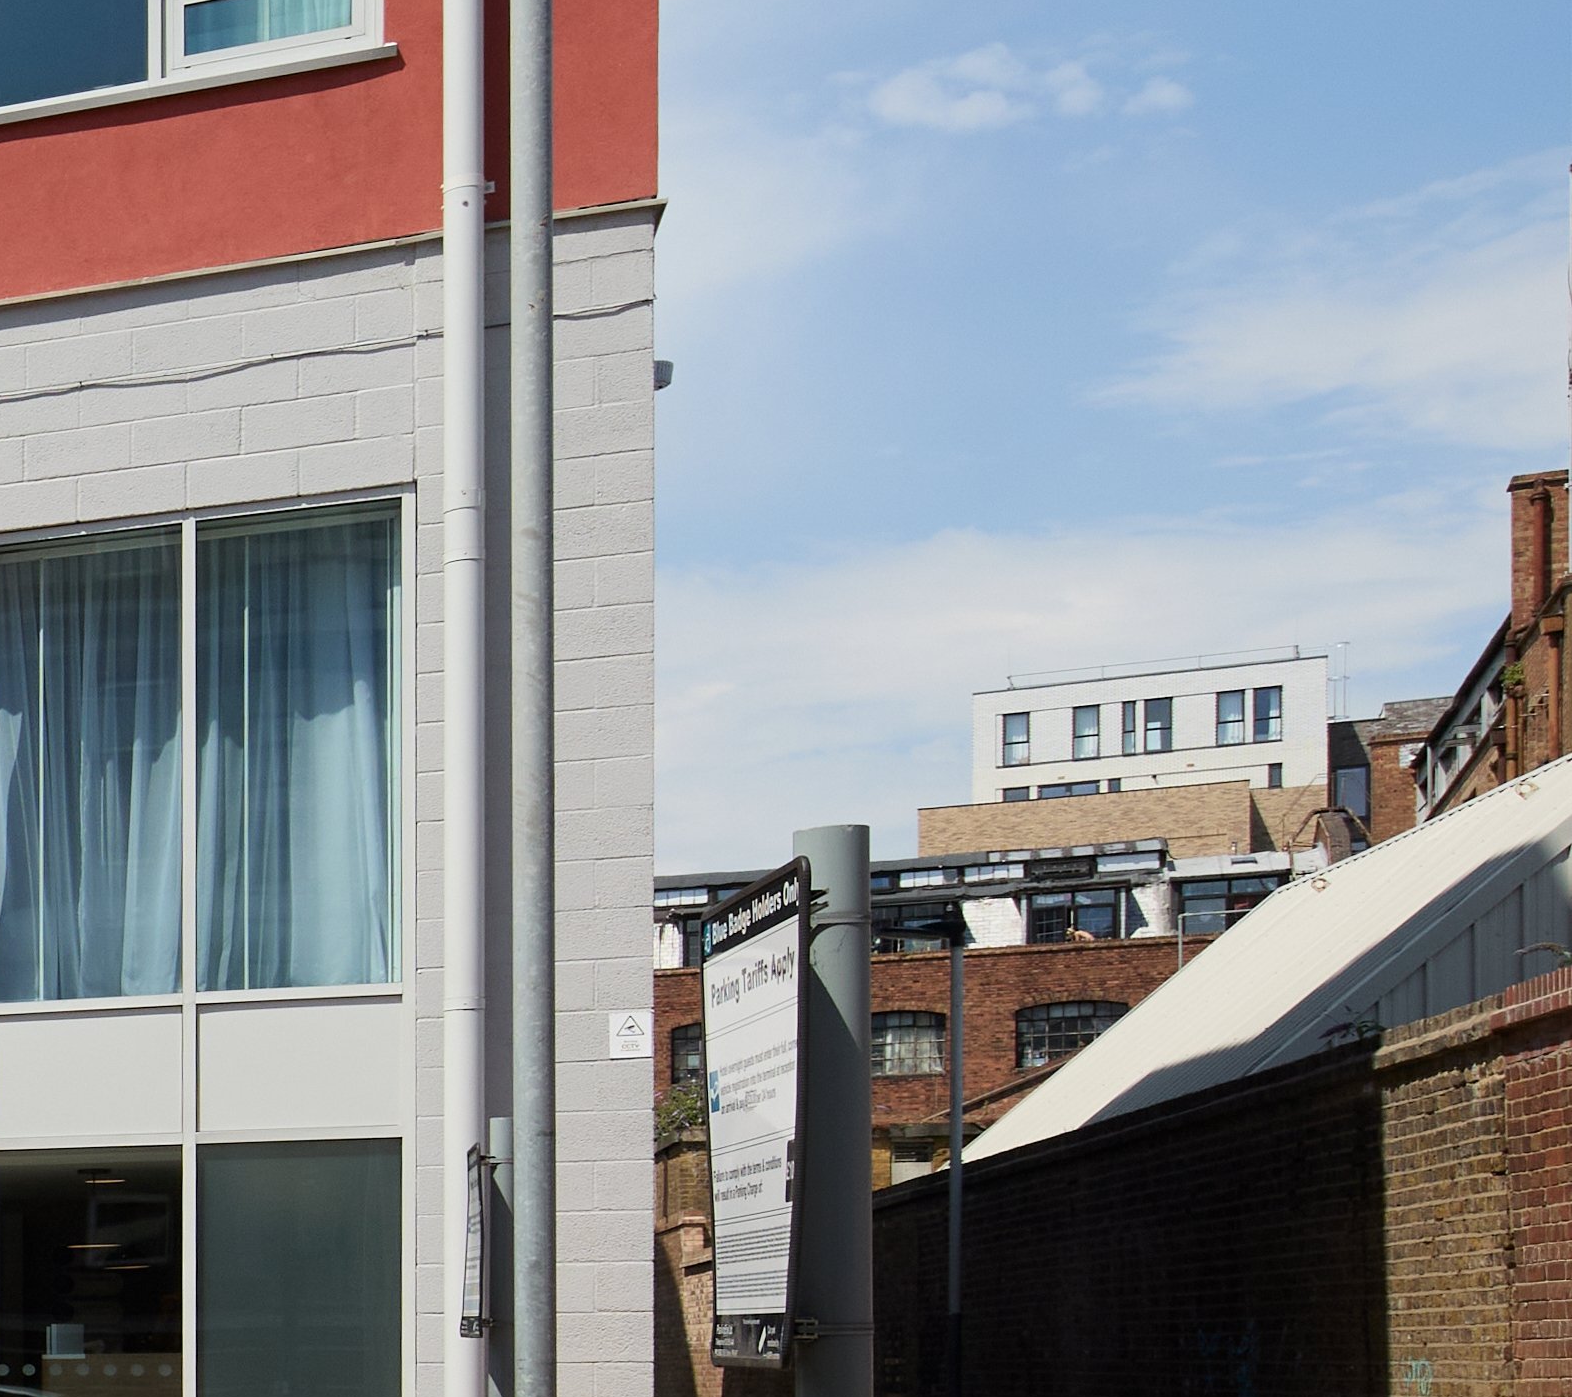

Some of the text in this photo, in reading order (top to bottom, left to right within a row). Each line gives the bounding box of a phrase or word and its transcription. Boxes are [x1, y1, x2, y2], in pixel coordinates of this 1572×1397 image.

[712, 919, 728, 945] Blue
[728, 907, 751, 935] Badge
[752, 892, 781, 922] Holders
[711, 946, 795, 1008] Parking Tariffs Apply
